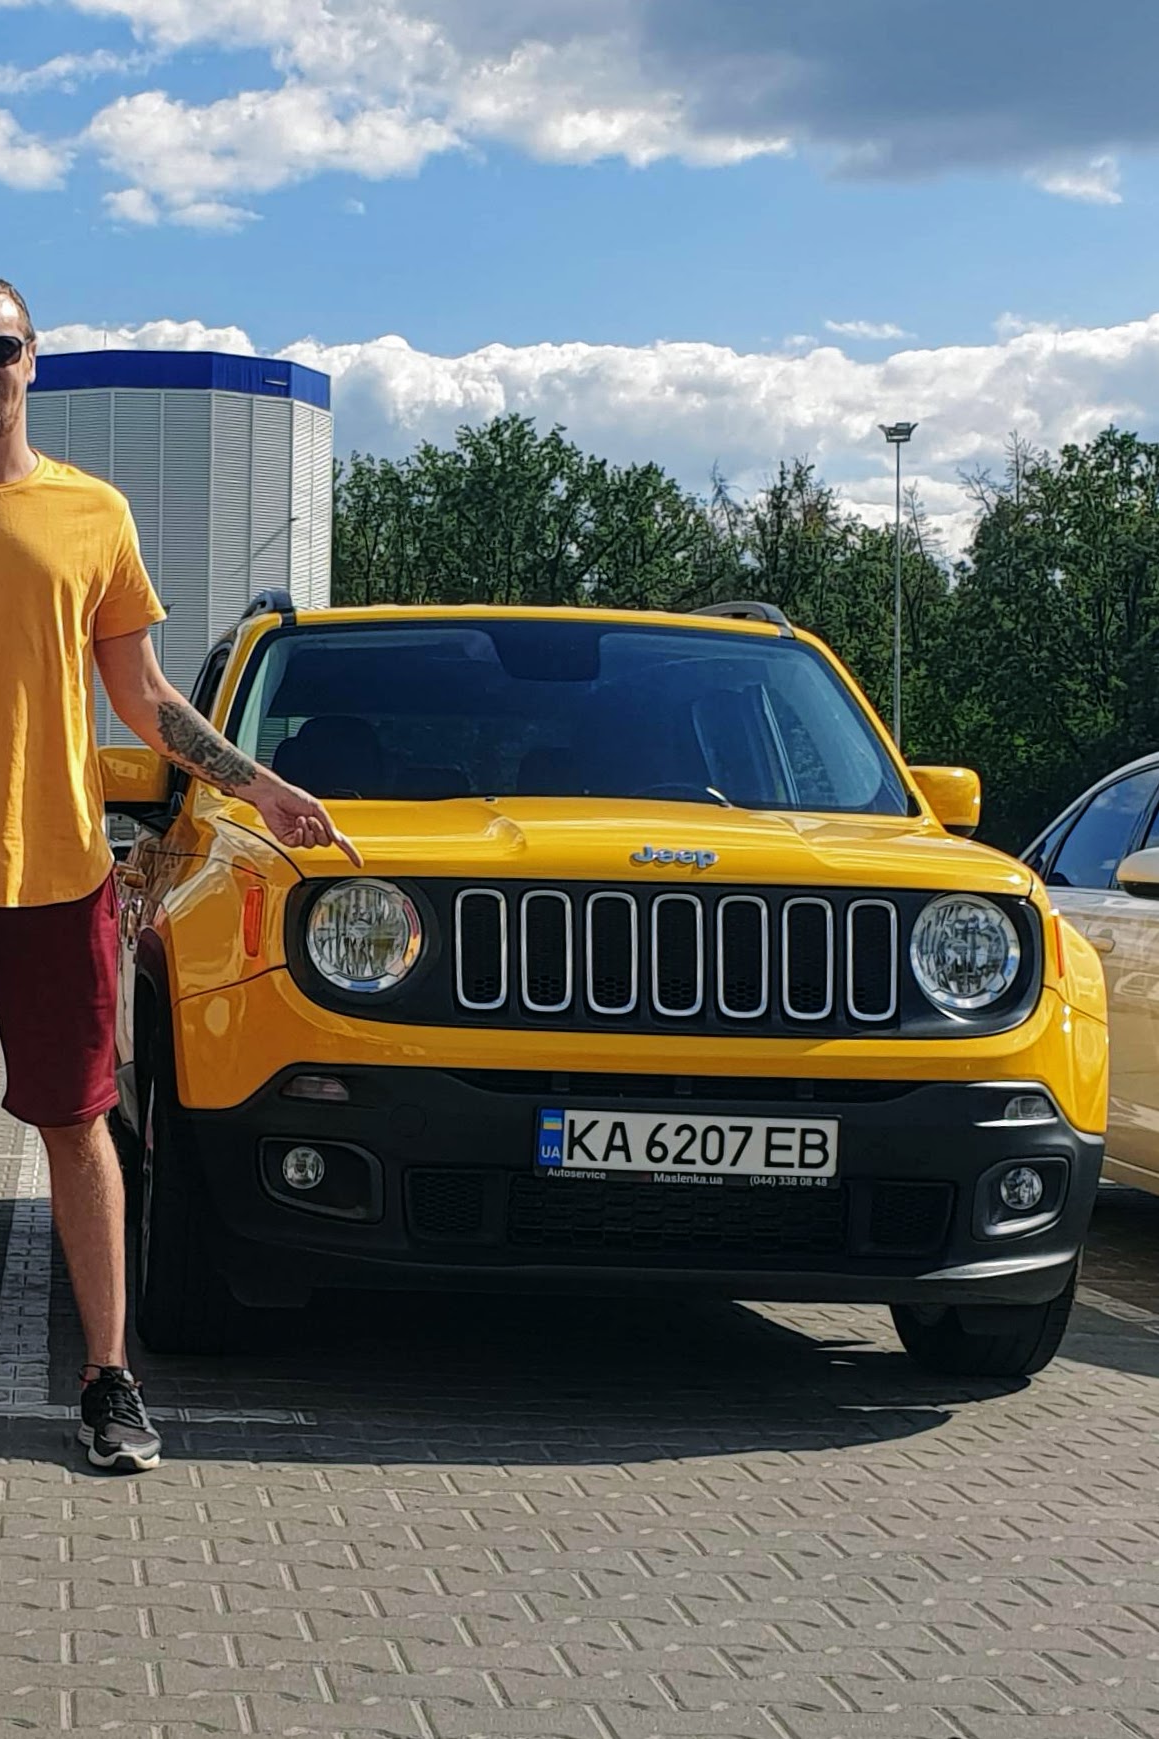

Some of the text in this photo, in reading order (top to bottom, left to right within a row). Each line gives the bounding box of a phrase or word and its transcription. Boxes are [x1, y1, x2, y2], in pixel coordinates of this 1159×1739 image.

[629, 842, 718, 869] Jeep
[541, 1145, 561, 1159] UA
[566, 1118, 830, 1169] KA 6207 EB
[546, 1167, 607, 1180] Autoservice
[653, 1172, 724, 1185] Maslenka.ua
[749, 1175, 776, 1188] (044)
[799, 1177, 813, 1187] 08
[814, 1177, 828, 1187] 48
